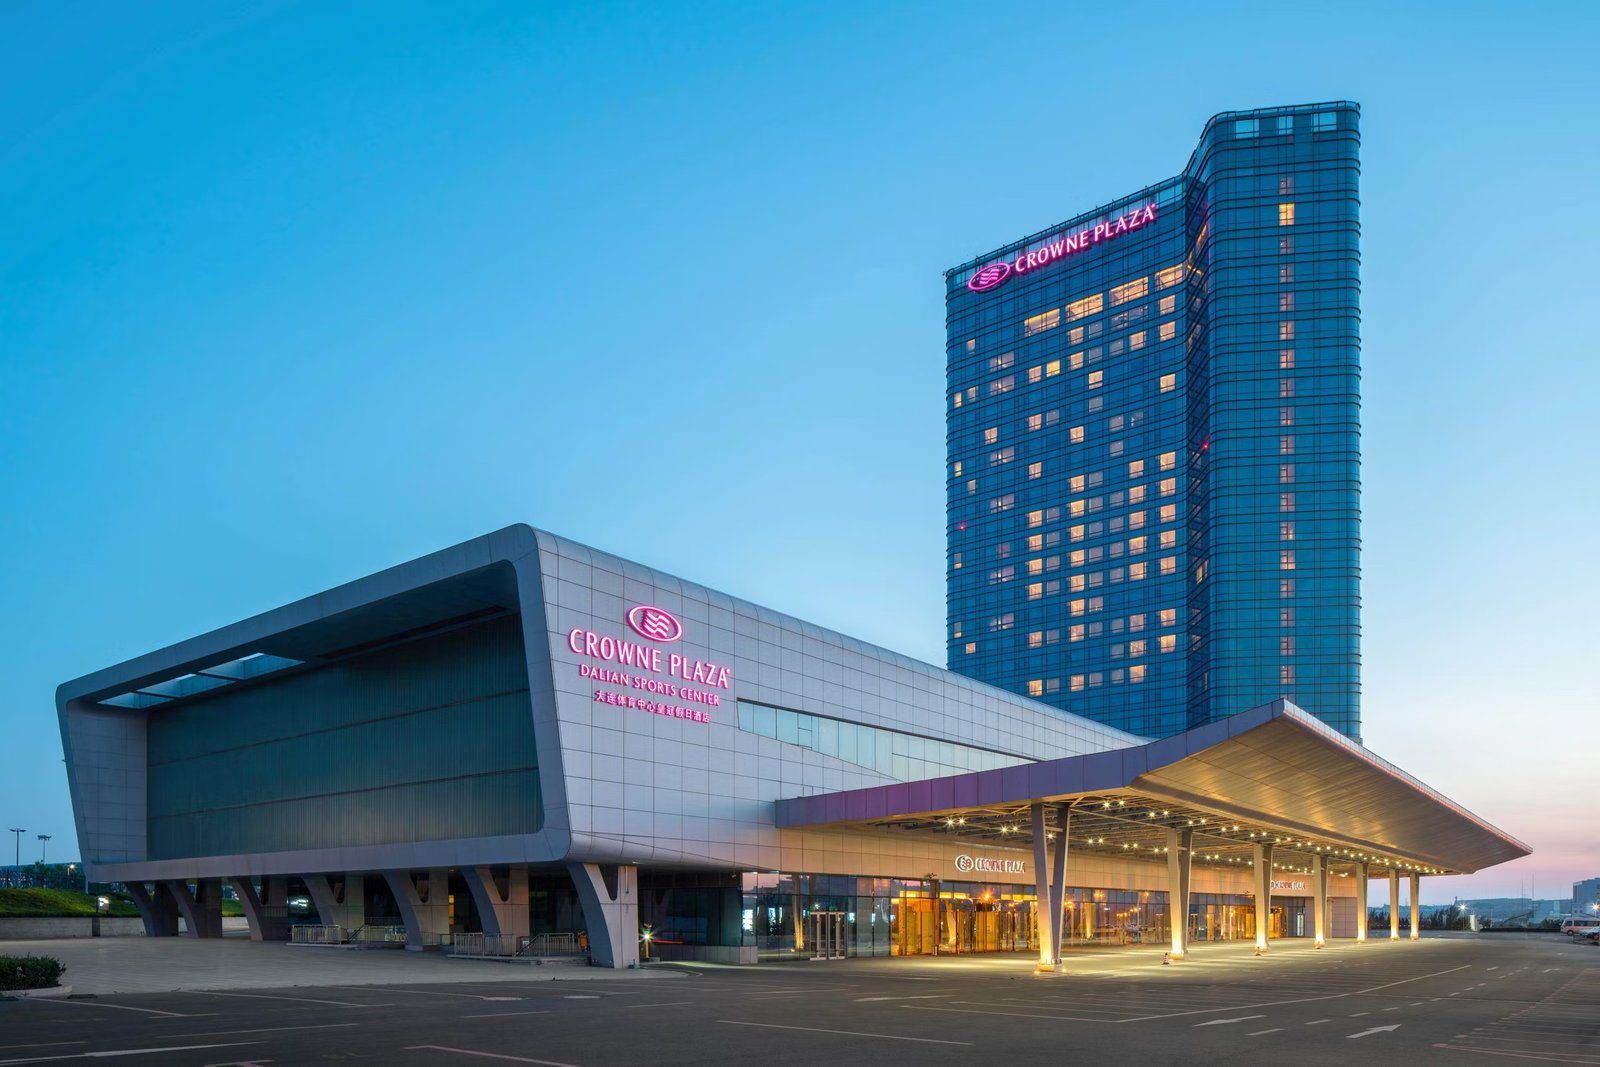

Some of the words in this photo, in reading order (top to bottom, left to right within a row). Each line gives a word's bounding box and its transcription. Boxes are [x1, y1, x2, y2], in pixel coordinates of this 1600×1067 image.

[1014, 230, 1090, 273] CROWNE
[1093, 204, 1156, 242] PLAZA
[568, 628, 662, 673] CROWNE
[668, 653, 731, 689] PLAZA
[579, 664, 630, 687] DALIAN
[633, 676, 677, 697] SPORTS
[679, 687, 721, 706] CENTER
